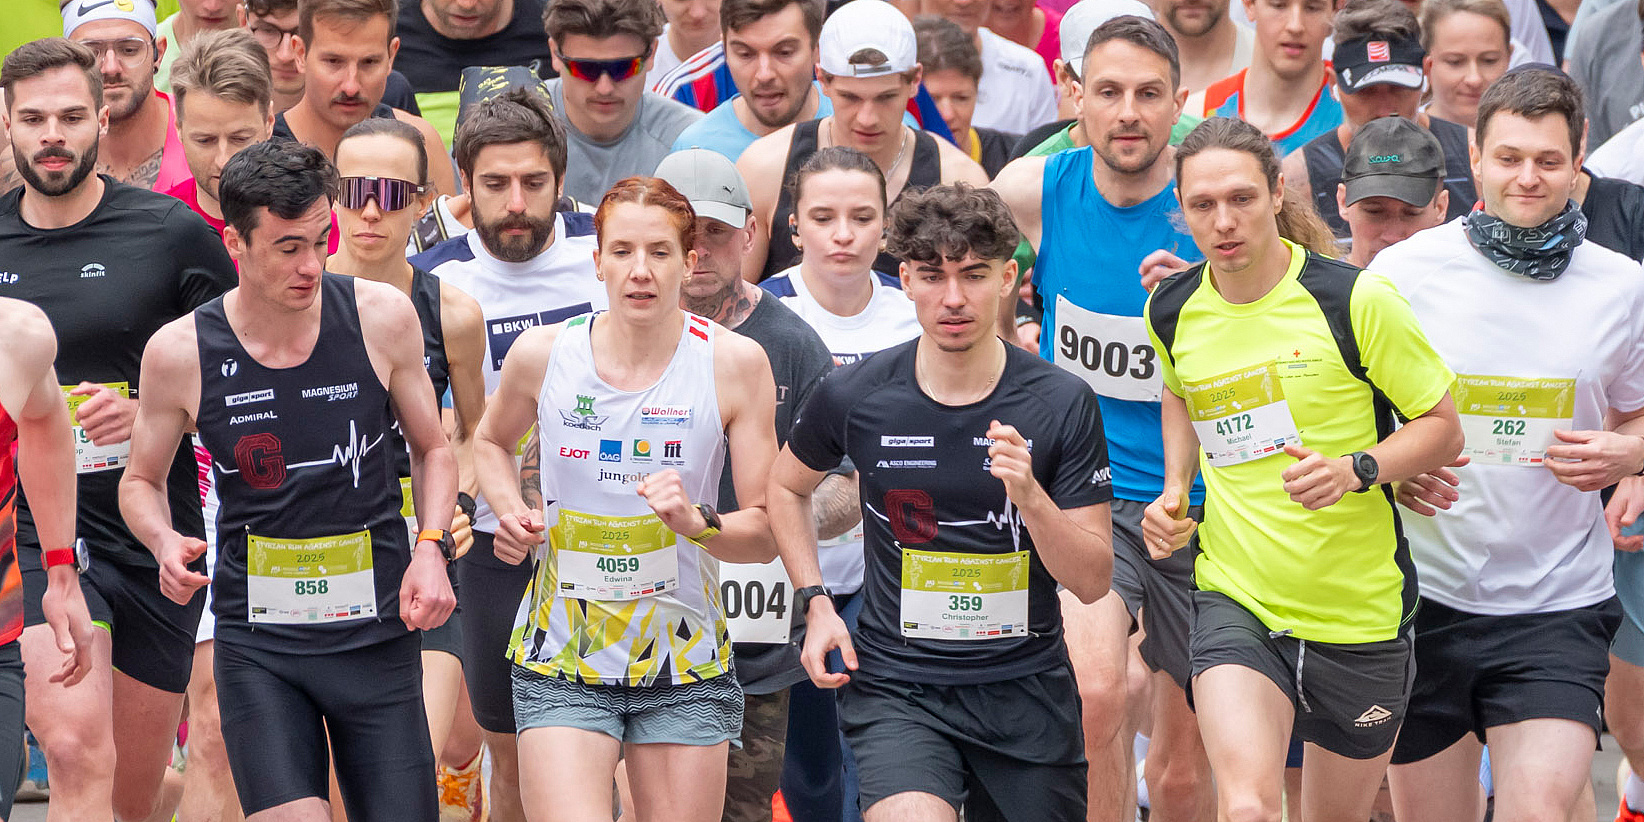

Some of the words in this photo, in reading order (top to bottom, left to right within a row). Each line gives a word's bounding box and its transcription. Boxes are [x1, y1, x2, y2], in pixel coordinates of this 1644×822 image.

[80, 271, 106, 279] skinfit
[503, 318, 534, 333] BKW
[1060, 324, 1156, 380] 9003
[232, 394, 249, 404] giga
[250, 389, 273, 400] sport
[301, 382, 359, 399] MAGNESIUM
[327, 390, 359, 402] SPORT
[1210, 387, 1237, 403] 2025
[1497, 391, 1527, 402] 2025
[229, 410, 278, 426] ADMIRAL
[650, 407, 688, 416] Wallner
[1216, 413, 1255, 436] 4172
[1492, 419, 1527, 436] 262
[888, 438, 908, 446] giga
[909, 437, 933, 445] sport
[1225, 433, 1252, 446] Michael
[234, 432, 287, 490] G
[559, 447, 590, 460] EJOT
[883, 489, 939, 544] G
[602, 531, 630, 541] 2025
[296, 552, 326, 563] 2025
[596, 556, 641, 573] 4059
[604, 575, 634, 583] Edwina
[951, 568, 981, 578] 2025
[295, 579, 330, 596] 858
[948, 594, 983, 612] 359
[942, 612, 990, 622] Christopher
